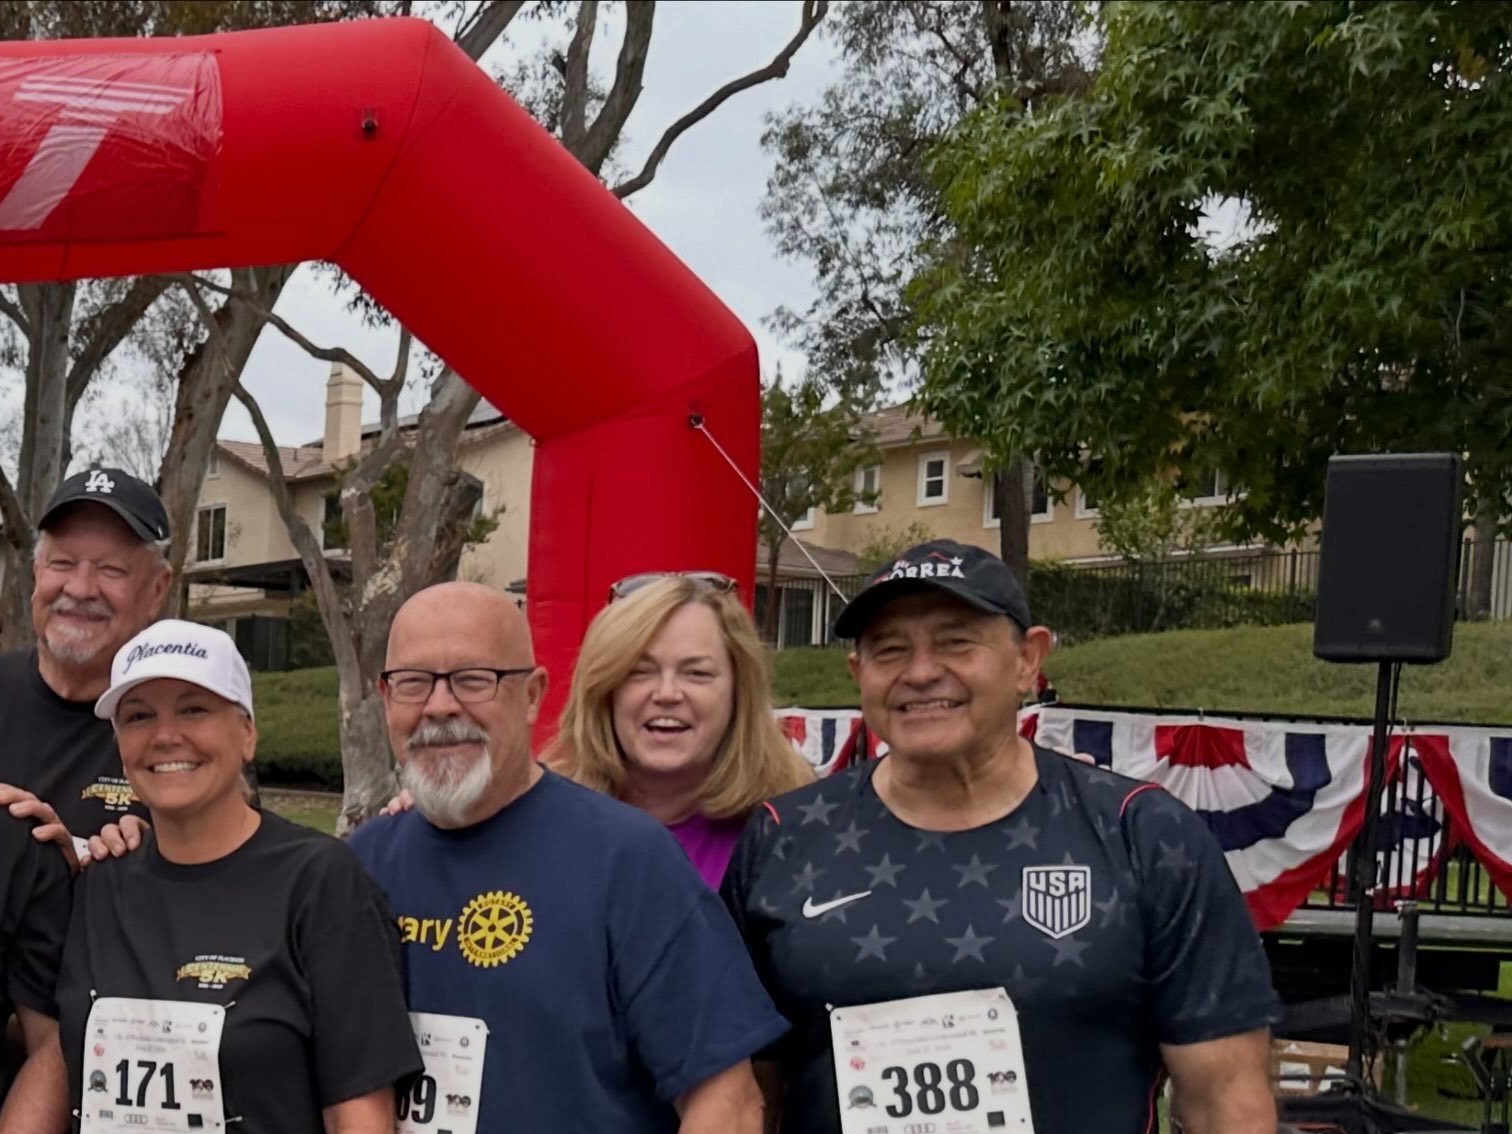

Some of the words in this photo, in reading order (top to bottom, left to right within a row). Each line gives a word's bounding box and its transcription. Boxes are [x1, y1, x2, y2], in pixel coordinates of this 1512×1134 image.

[85, 470, 115, 493] LA
[886, 560, 966, 579] ORREA
[123, 642, 209, 675] Placentia
[105, 792, 131, 805] 5K
[1029, 871, 1085, 897] USA
[398, 914, 453, 951] ary
[199, 970, 227, 983] 5K
[115, 1059, 181, 1110] 171
[881, 1058, 979, 1118] 388
